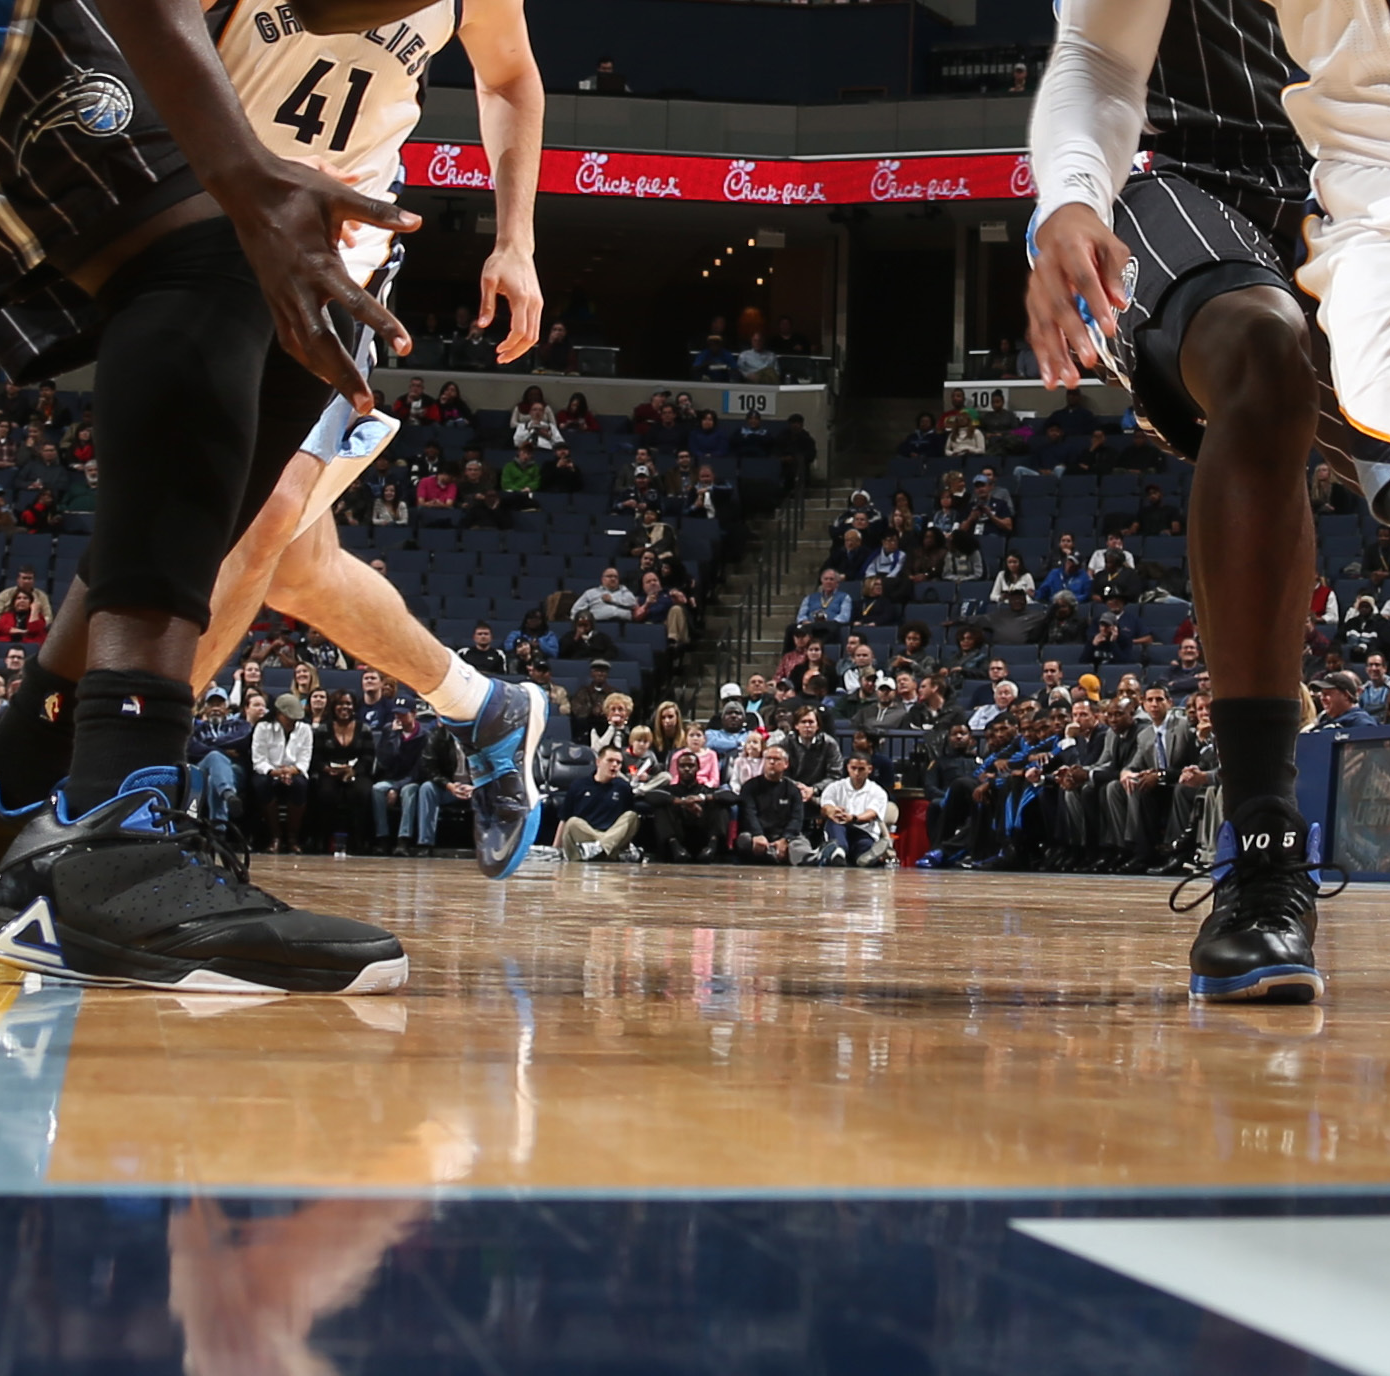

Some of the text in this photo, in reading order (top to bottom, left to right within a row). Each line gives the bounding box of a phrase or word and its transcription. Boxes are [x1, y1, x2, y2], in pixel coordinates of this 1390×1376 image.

[253, 3, 431, 77] GRLIES
[272, 58, 375, 152] 41
[428, 143, 496, 187] Chick-
[738, 394, 767, 412] 109
[1282, 831, 1297, 849] 5
